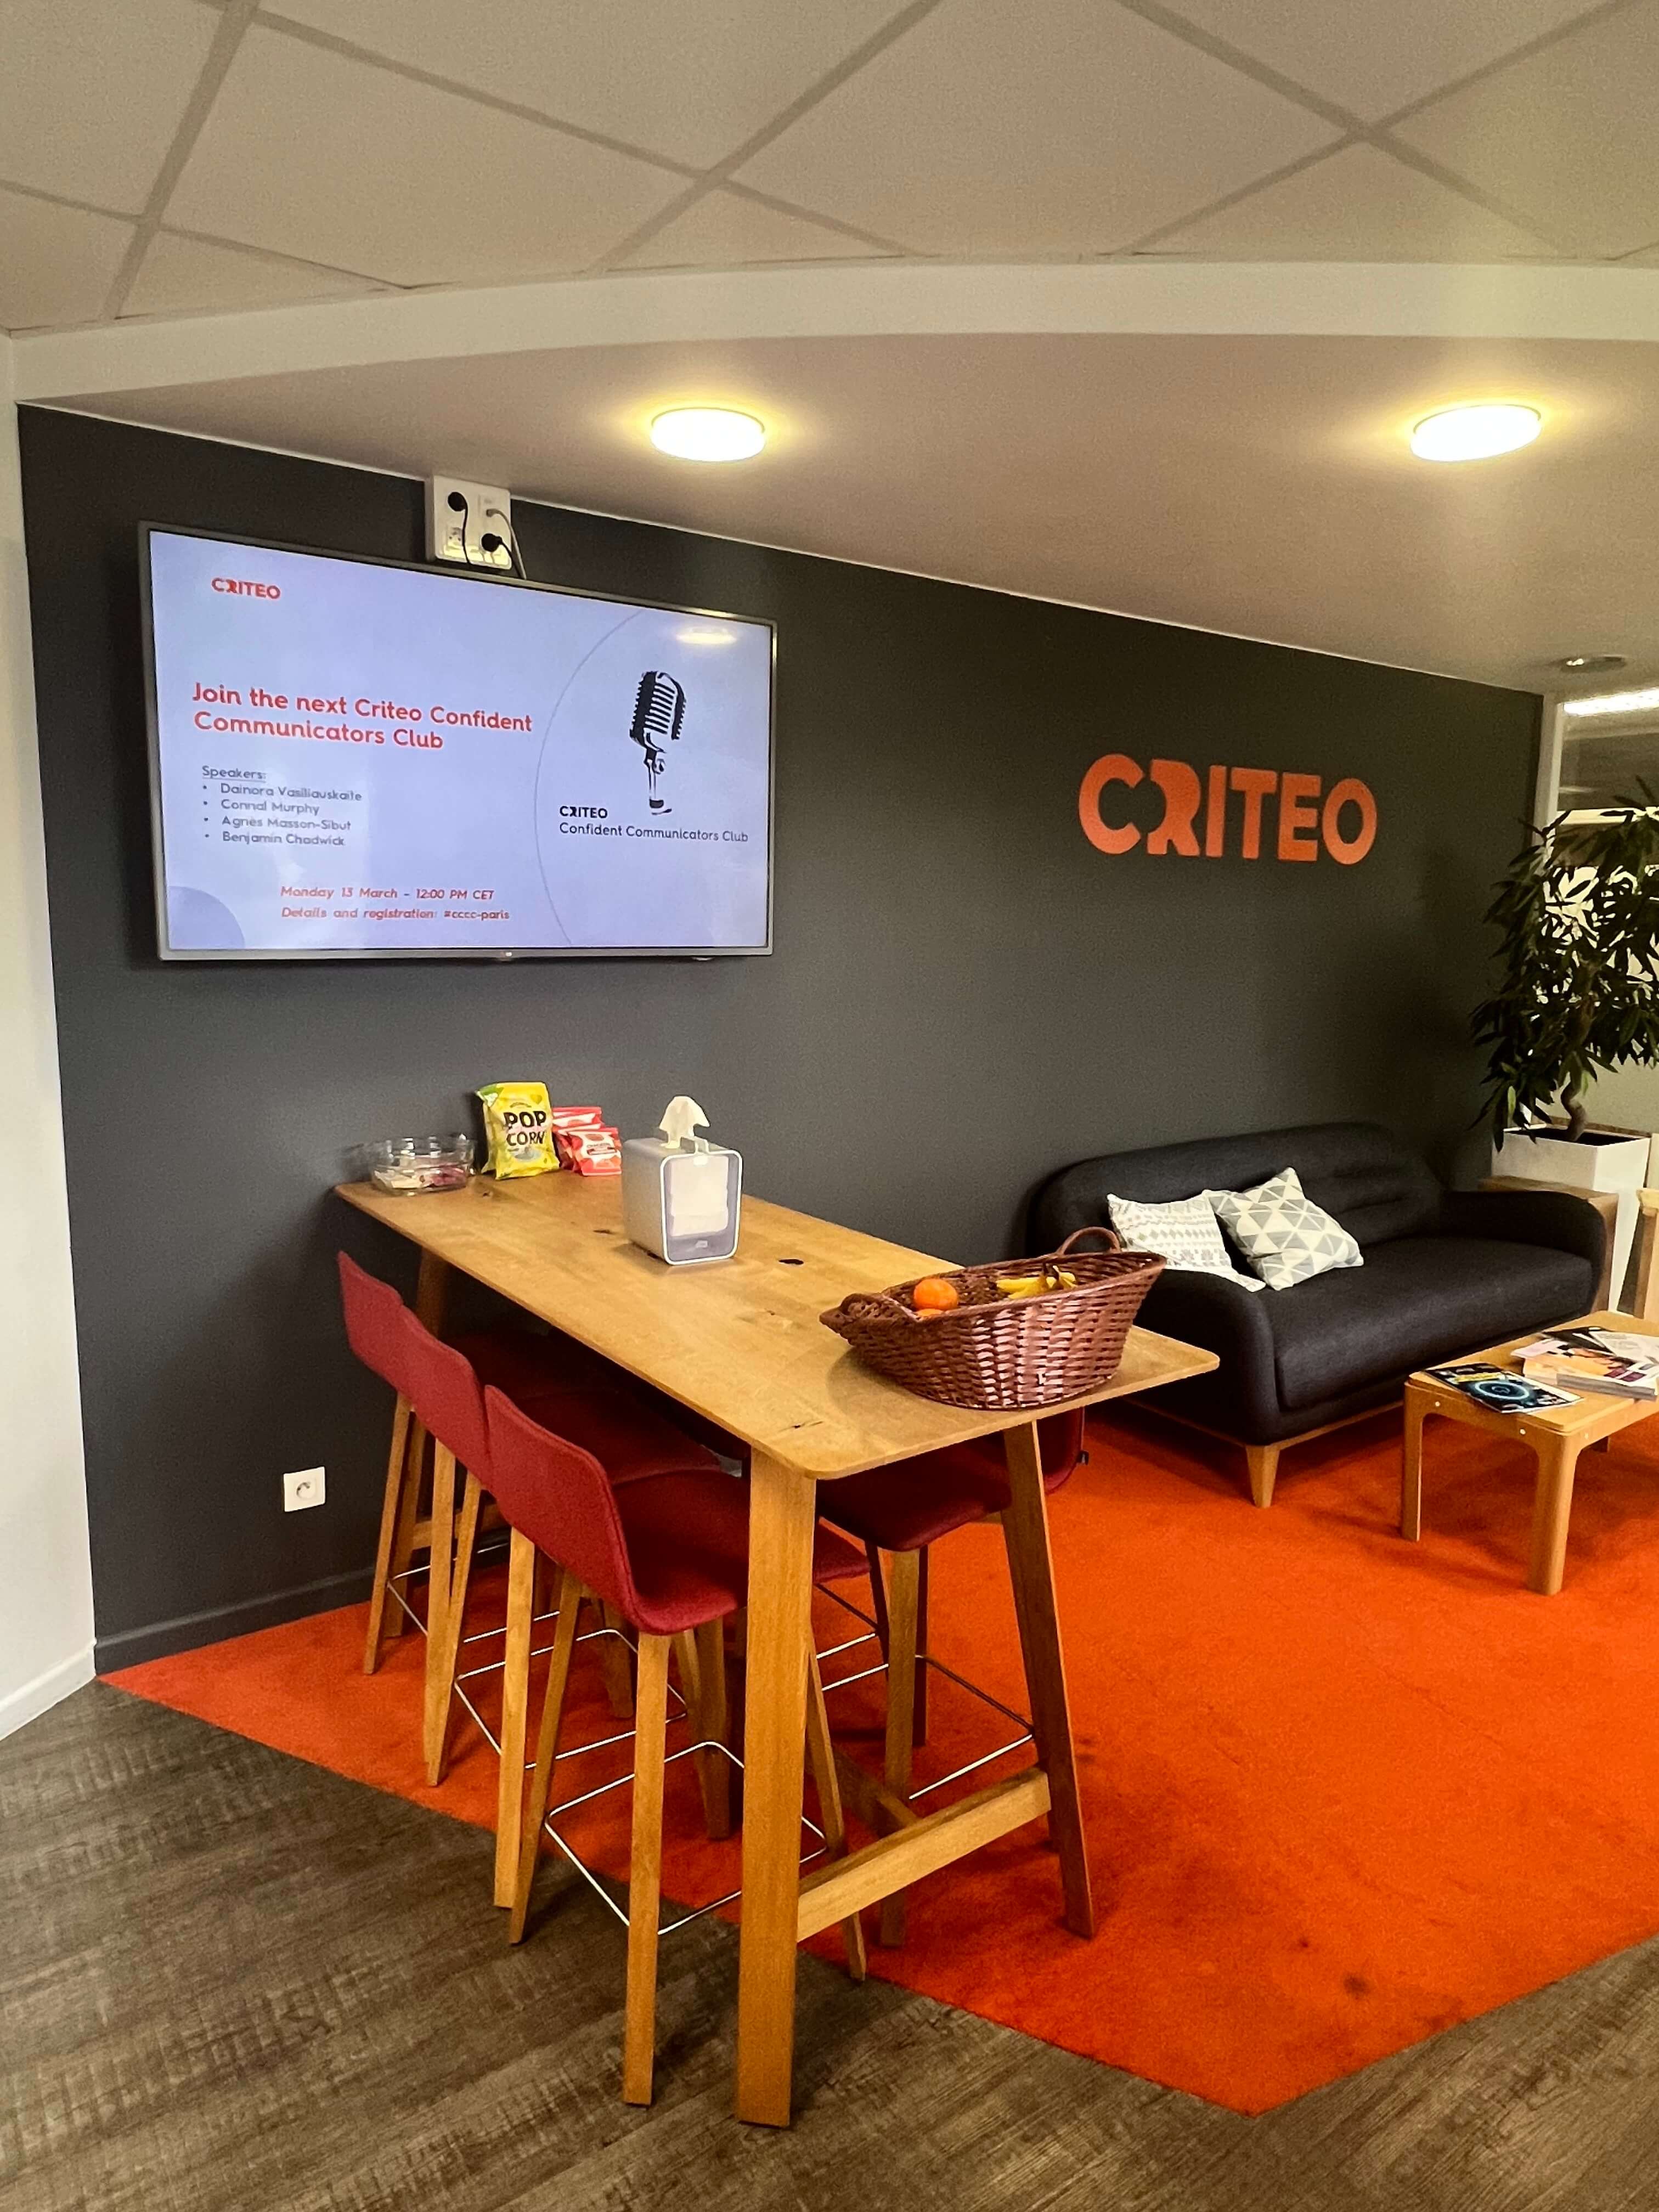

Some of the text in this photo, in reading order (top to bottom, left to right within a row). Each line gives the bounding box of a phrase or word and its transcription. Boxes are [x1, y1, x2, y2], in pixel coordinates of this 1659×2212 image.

[211, 577, 280, 600] CRITEO
[193, 682, 532, 732] Join the next Criteo Confident
[194, 711, 443, 749] Communicators Club
[202, 765, 266, 781] Speakers:
[221, 783, 274, 797] Dainora
[221, 799, 319, 816] Connal Murphy
[559, 805, 608, 819] CRITEO
[1079, 753, 1378, 865] CRITEO
[268, 818, 351, 831] Masson-Sibut
[559, 822, 748, 843] Confident Communicators Club
[223, 831, 345, 846] Benjamin Chadwick
[280, 886, 334, 900] Monday
[359, 888, 398, 899] March
[416, 888, 445, 899] 12:00
[450, 890, 467, 900] PM
[473, 890, 494, 900] CET
[281, 907, 326, 918] Details
[333, 908, 358, 918] and
[503, 1111, 546, 1130] POP
[506, 1131, 545, 1146] CORN
